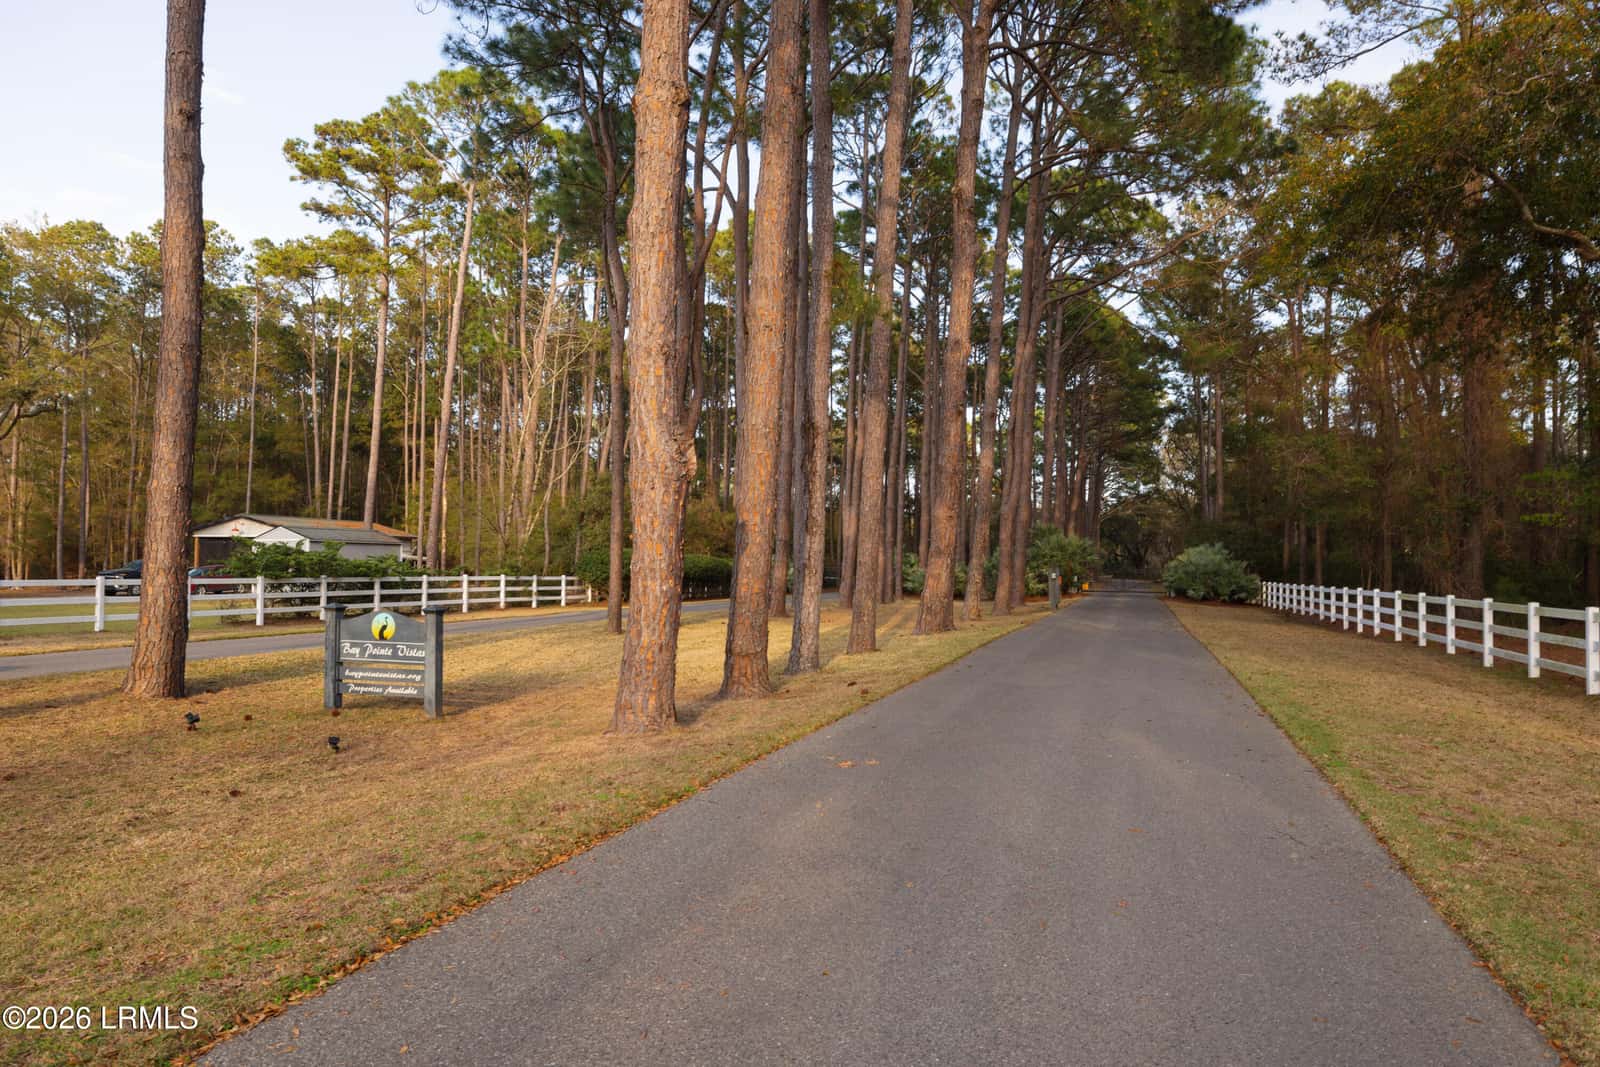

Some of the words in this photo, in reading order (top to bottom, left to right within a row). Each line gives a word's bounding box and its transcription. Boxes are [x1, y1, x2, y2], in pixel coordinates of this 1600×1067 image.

[341, 643, 360, 658] Bay
[363, 643, 392, 658] Pointe
[396, 645, 425, 657] Vistas
[345, 669, 422, 682] baypointevistas.org
[347, 684, 383, 694] Properties
[384, 686, 418, 695] Available
